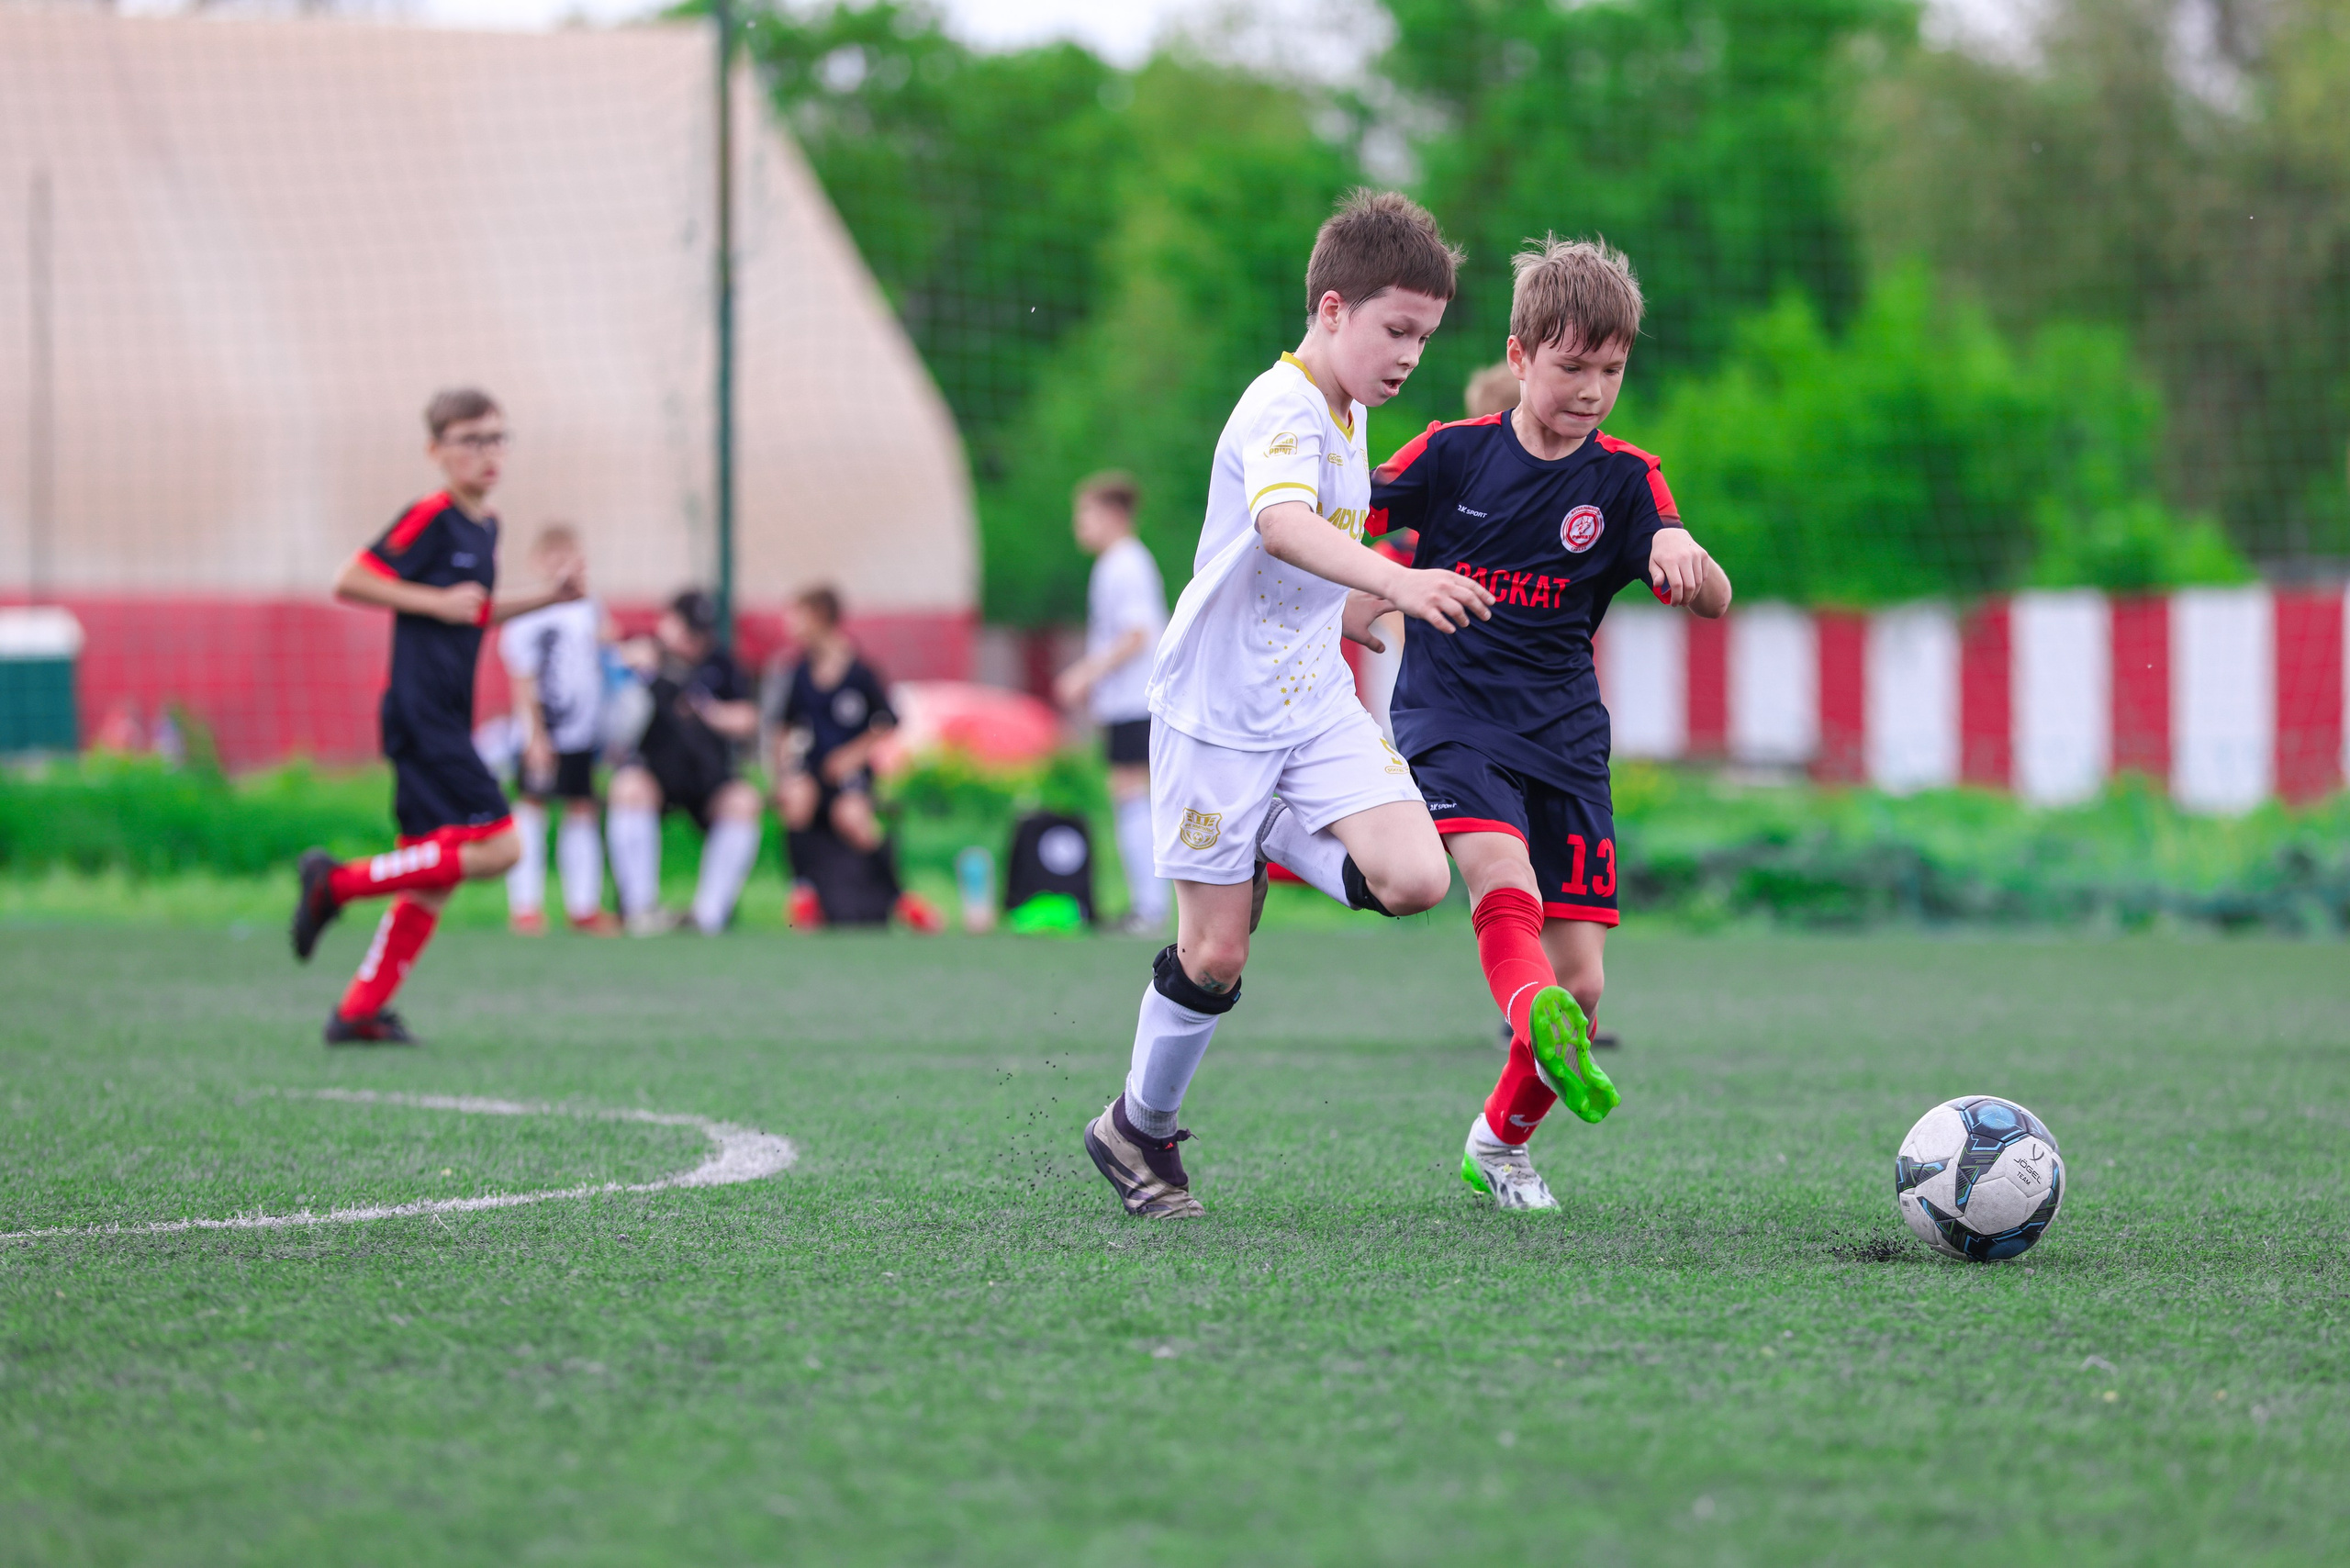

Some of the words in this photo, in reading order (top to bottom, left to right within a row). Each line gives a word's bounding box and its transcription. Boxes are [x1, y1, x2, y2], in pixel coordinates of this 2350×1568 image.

[1466, 509, 1488, 519] SPORT
[1561, 834, 1616, 898] 13
[2013, 1158, 2042, 1185] JÖGEL
[2017, 1170, 2031, 1185] TEAM
